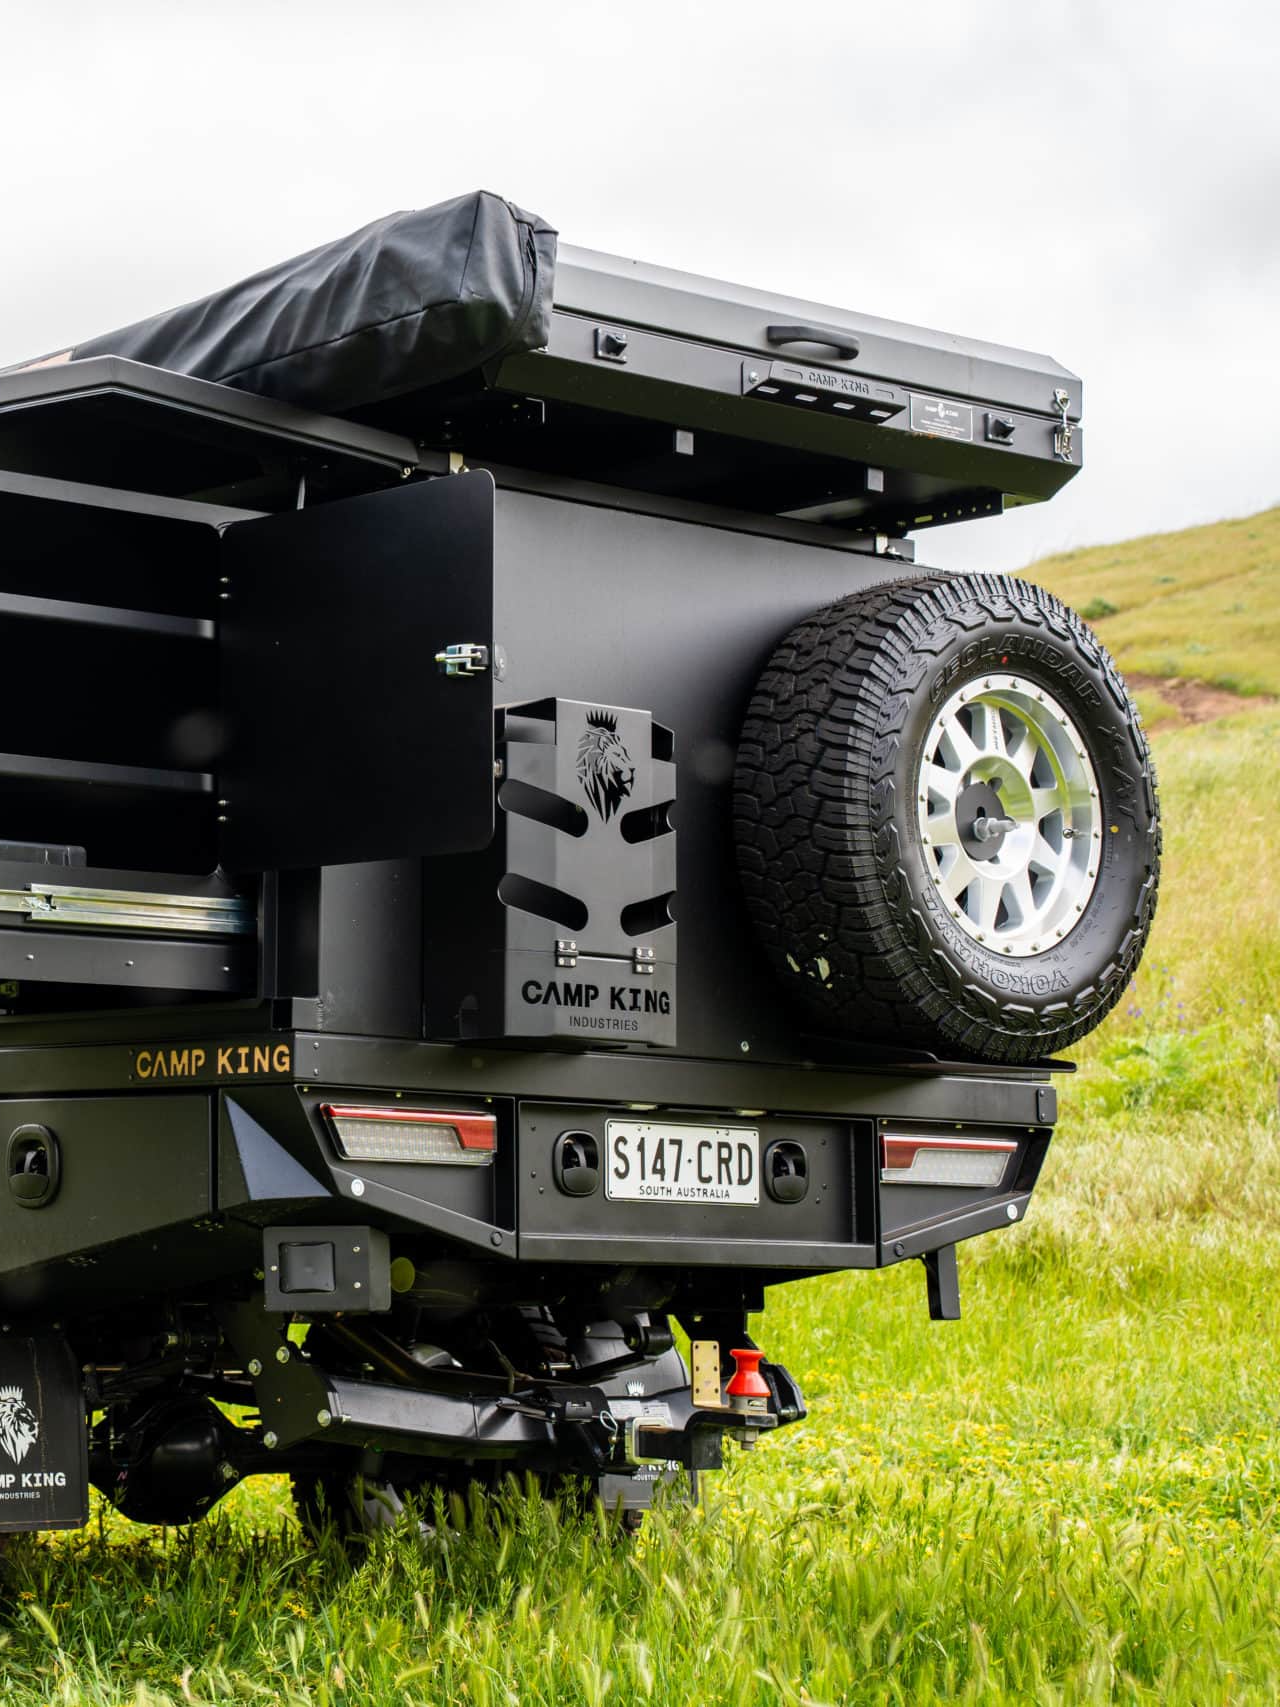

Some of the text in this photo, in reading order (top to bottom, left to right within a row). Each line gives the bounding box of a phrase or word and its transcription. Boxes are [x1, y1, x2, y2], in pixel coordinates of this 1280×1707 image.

[809, 372, 837, 387] CAMP
[921, 887, 1070, 996] YOKOHAMA
[521, 980, 670, 1014] CAMP KING
[569, 1015, 639, 1031] INDUSTRIES
[136, 1044, 290, 1078] CAMP KING
[639, 1185, 730, 1199] SOUTH AUSTRALIA
[21, 1472, 66, 1488] KING
